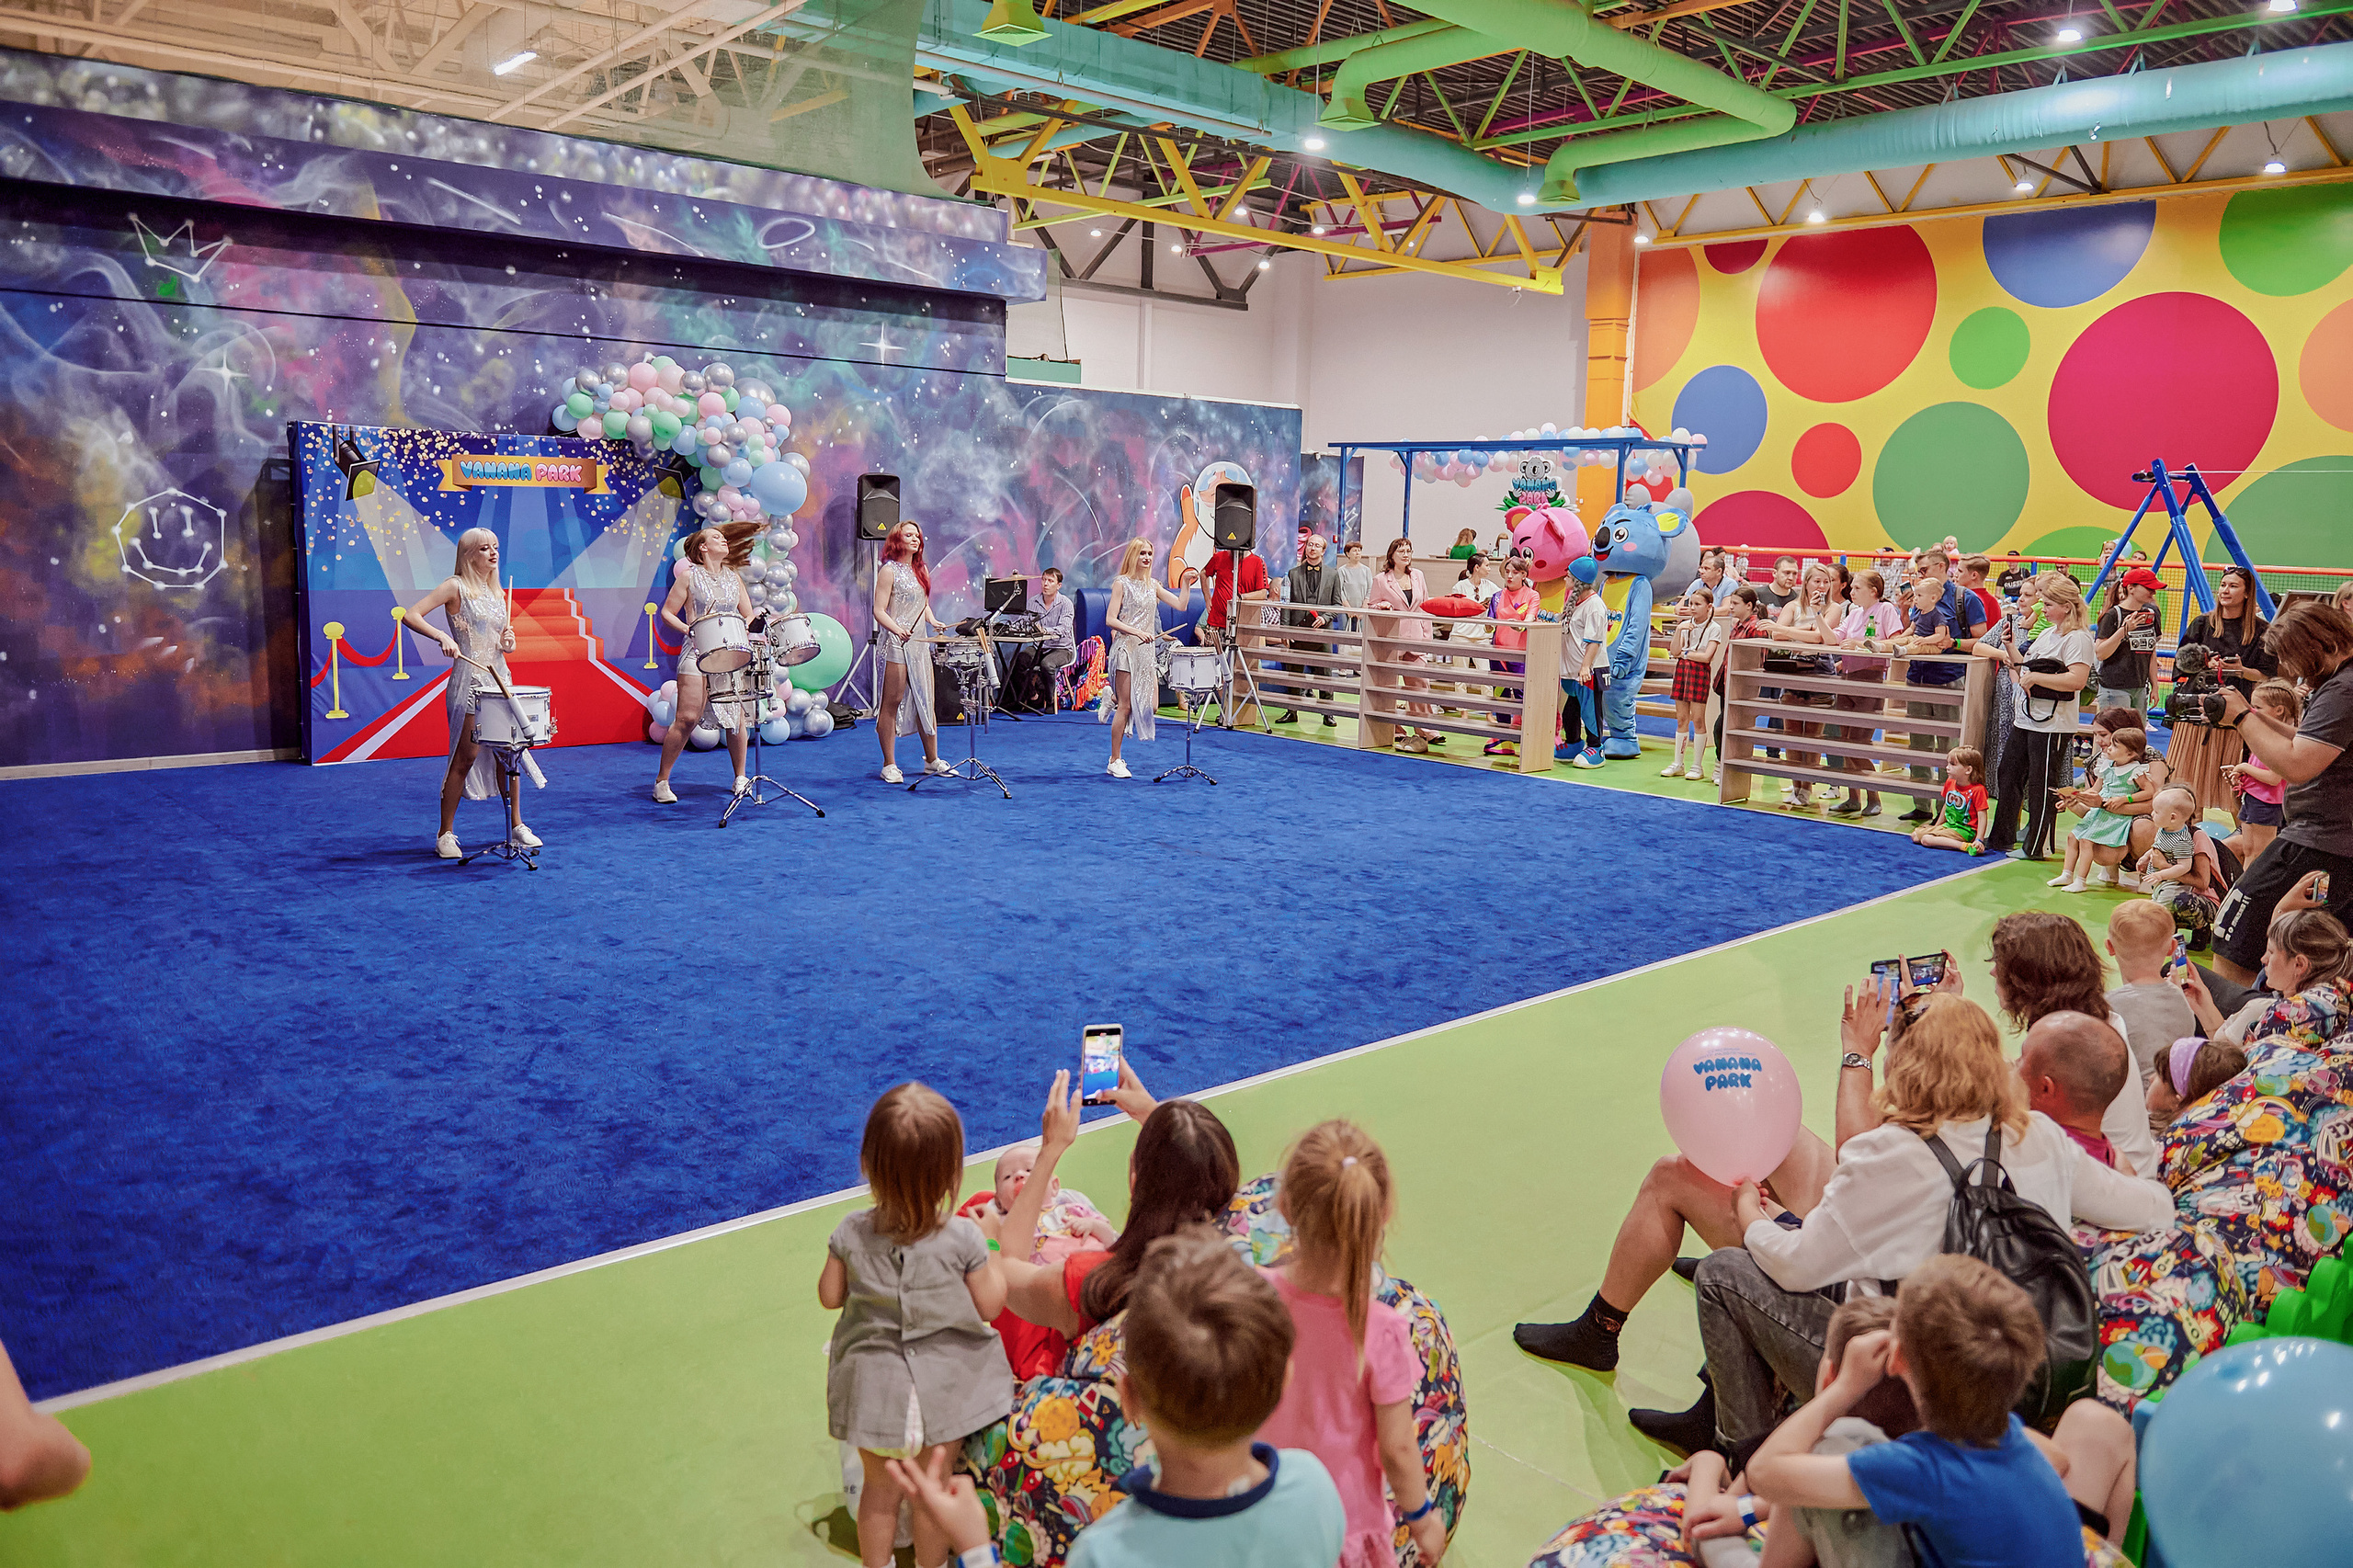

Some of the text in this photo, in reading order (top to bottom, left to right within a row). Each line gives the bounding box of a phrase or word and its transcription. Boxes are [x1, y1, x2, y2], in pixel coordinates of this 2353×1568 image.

[460, 460, 583, 483] VANANA PARK
[1693, 1057, 1762, 1074] VANANA
[1705, 1073, 1752, 1091] PARK
